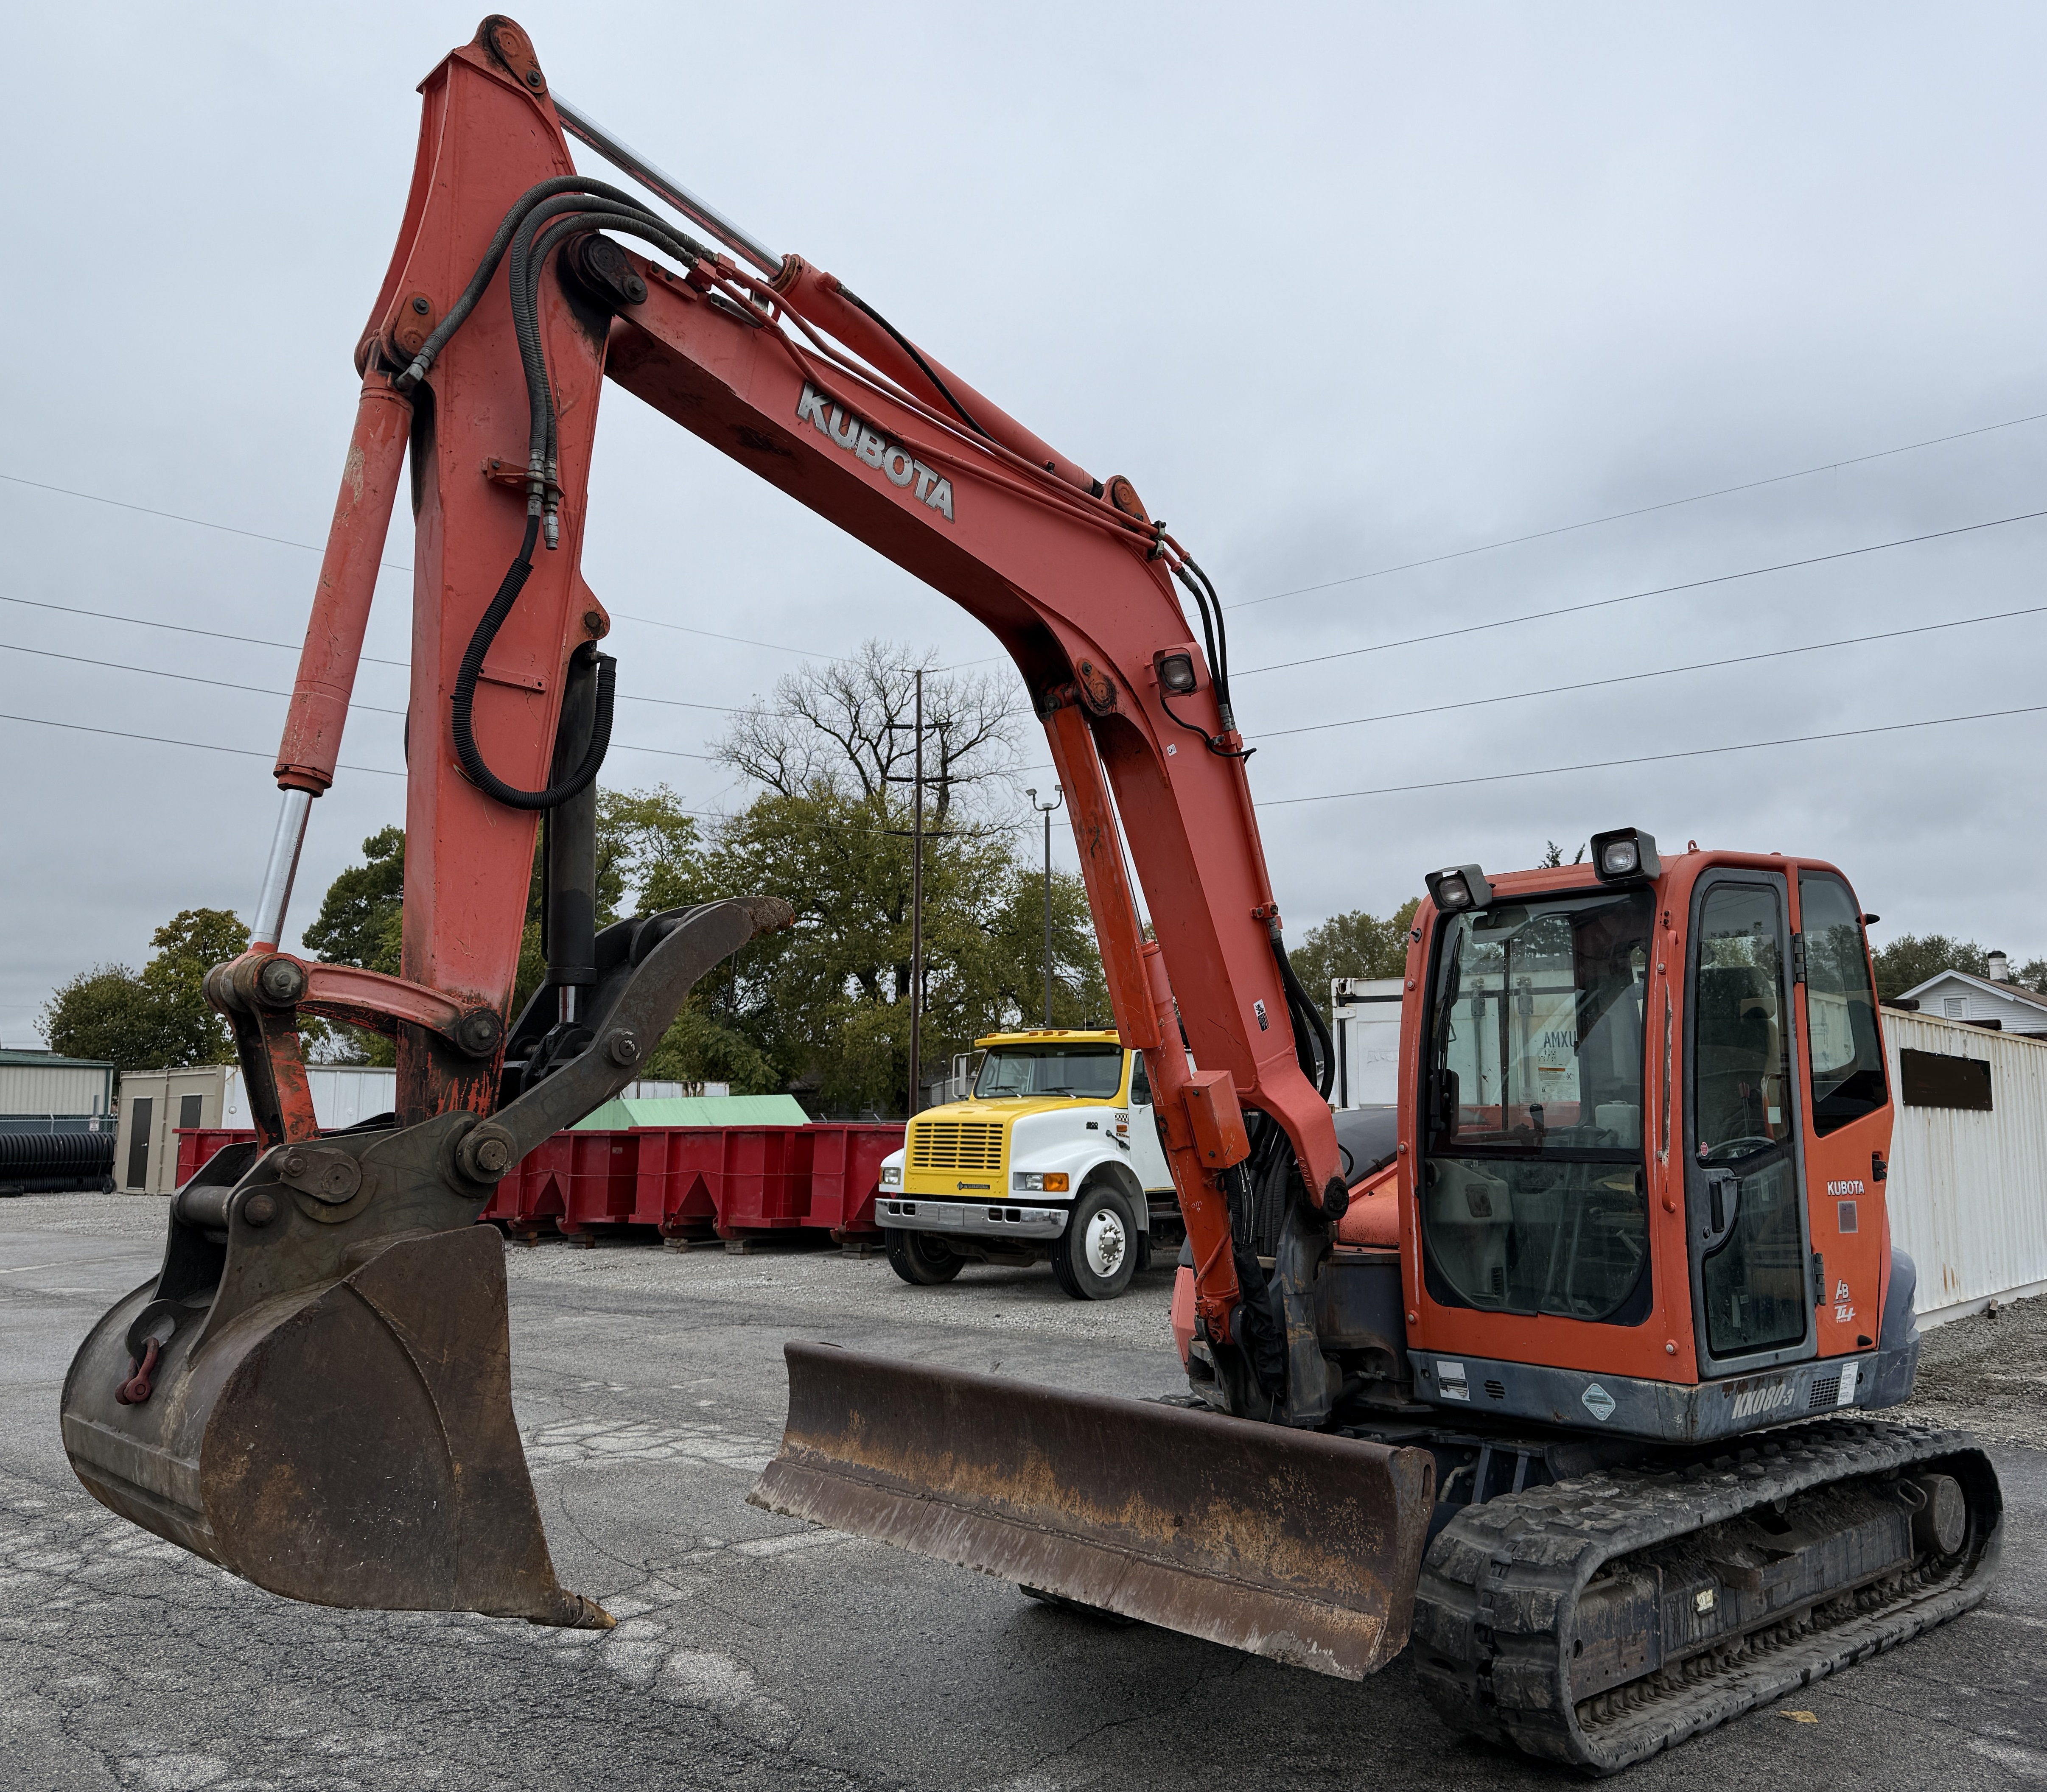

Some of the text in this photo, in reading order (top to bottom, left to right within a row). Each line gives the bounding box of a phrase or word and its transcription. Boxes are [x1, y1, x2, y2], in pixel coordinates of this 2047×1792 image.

[796, 381, 955, 523] KUBOTA
[1827, 1180, 1865, 1196] KUBOTA
[1731, 1384, 1795, 1419] KX080-3
